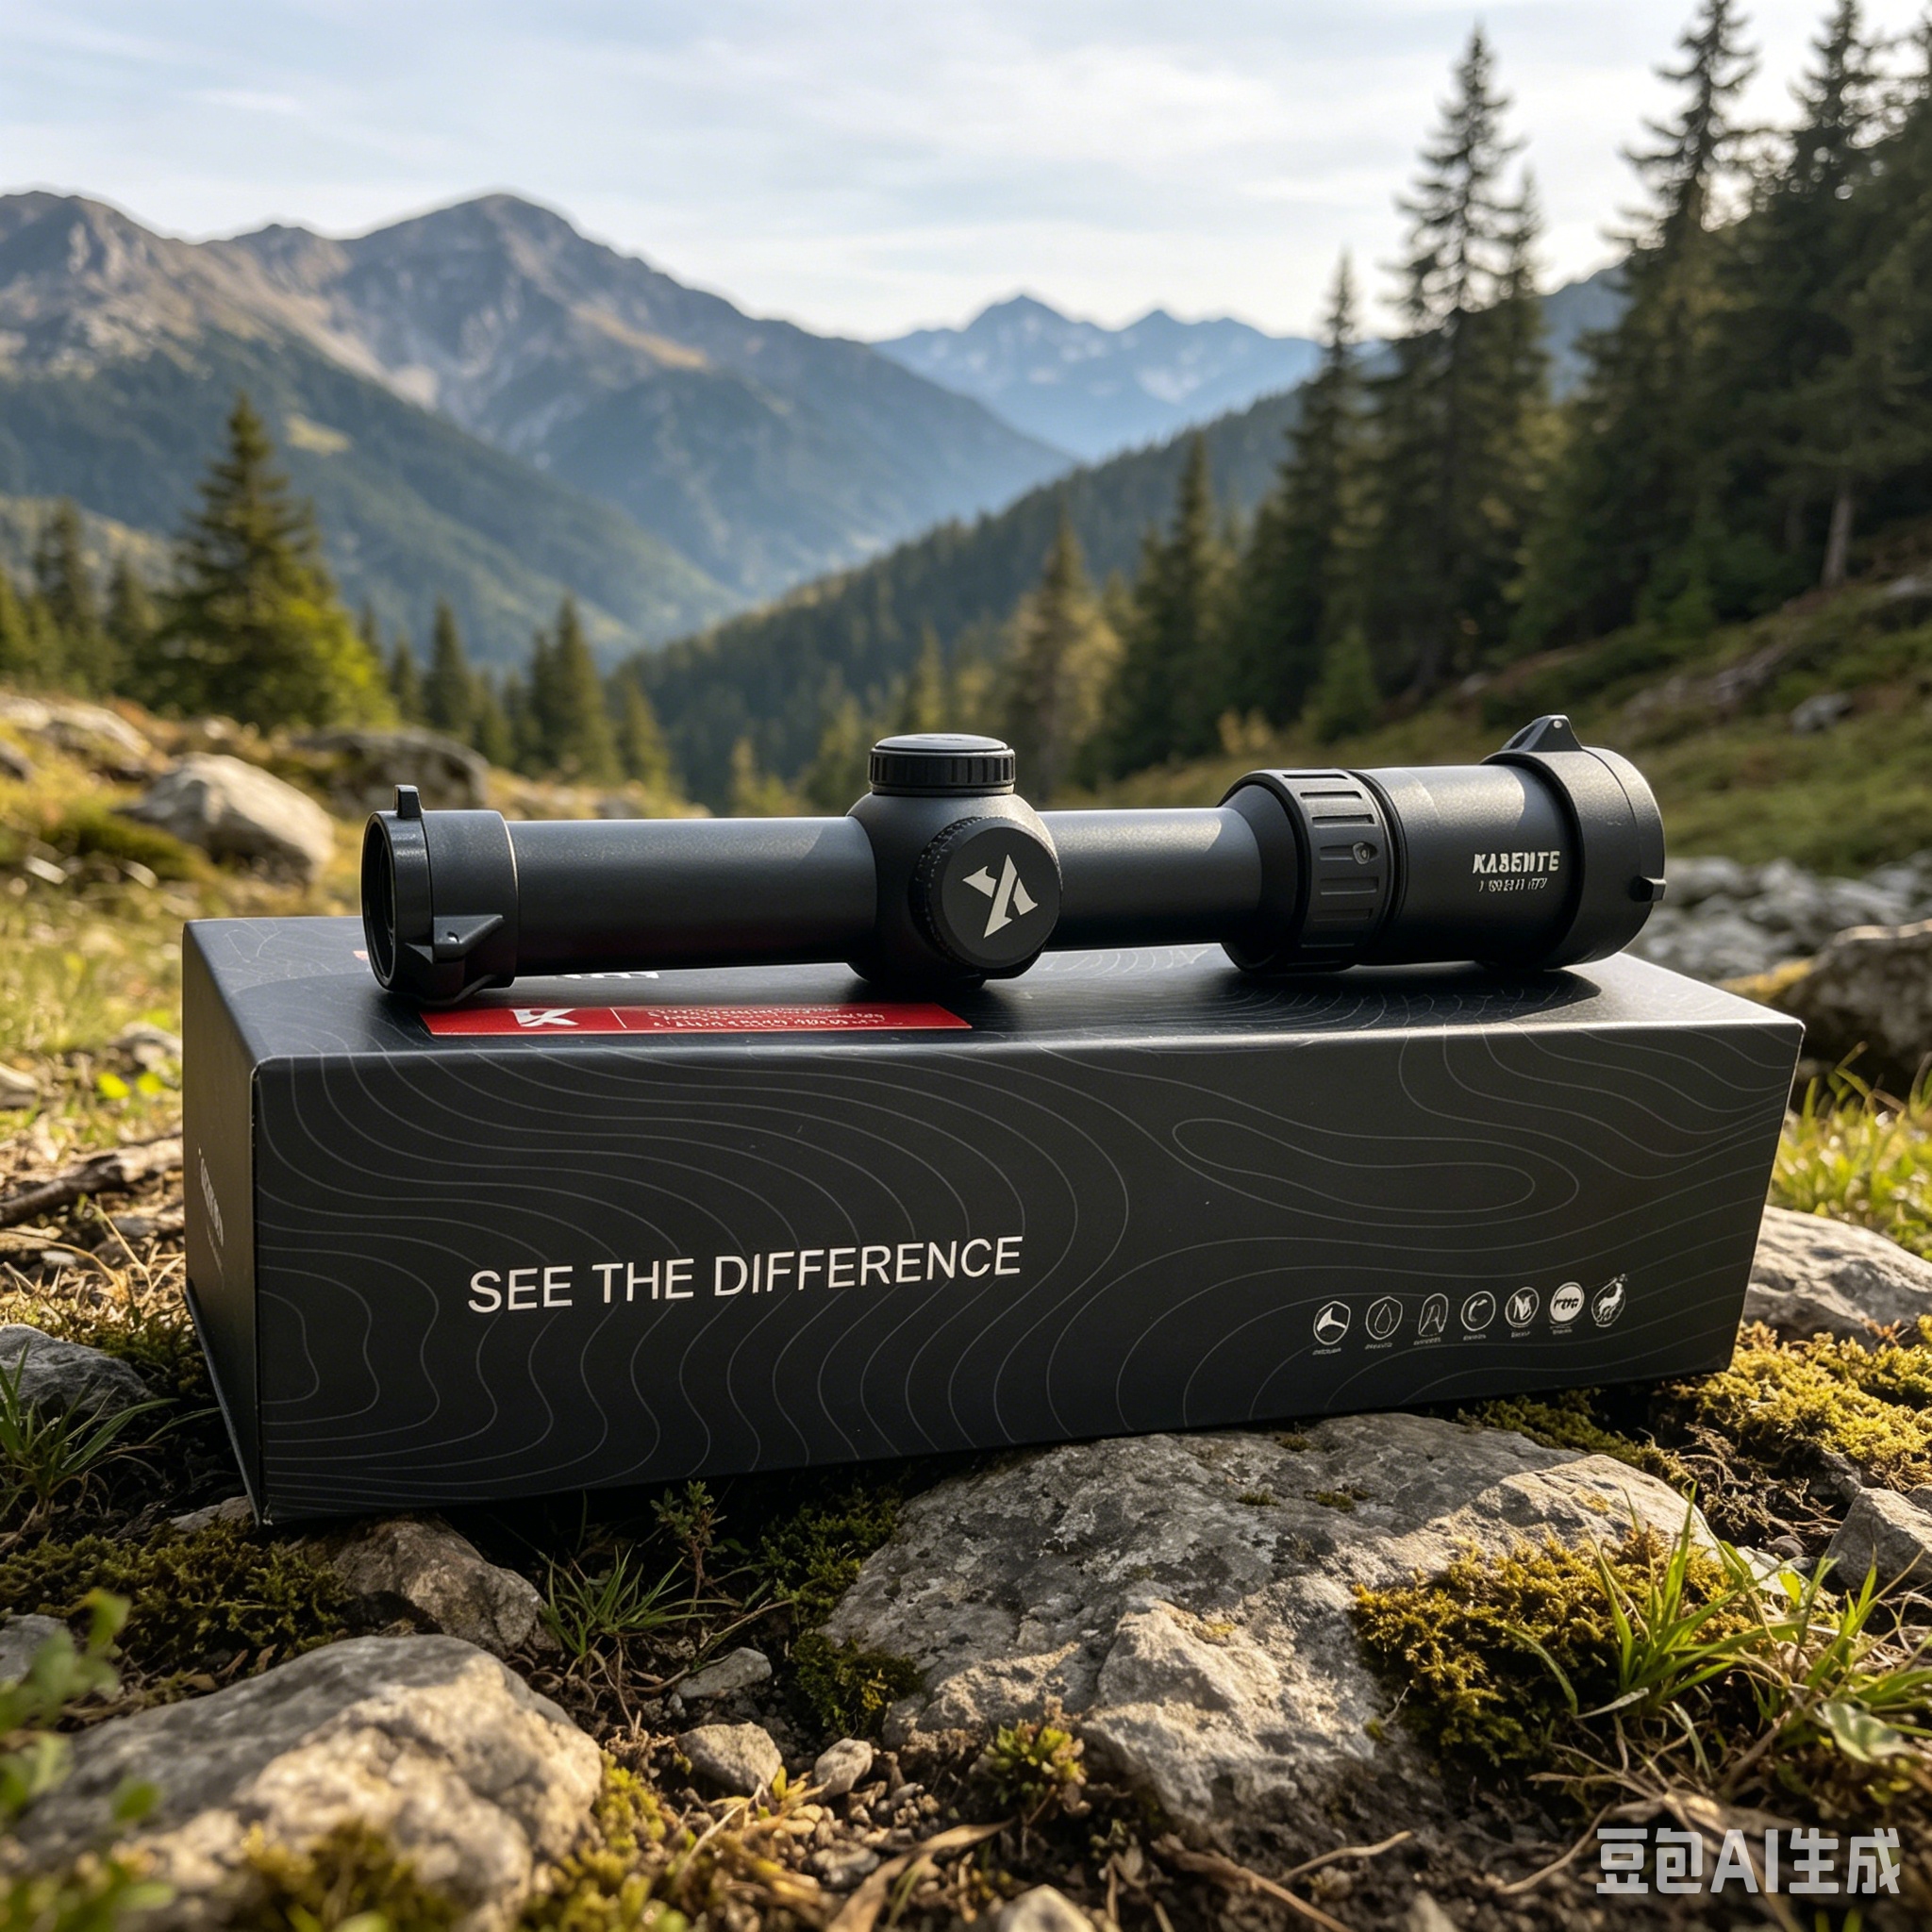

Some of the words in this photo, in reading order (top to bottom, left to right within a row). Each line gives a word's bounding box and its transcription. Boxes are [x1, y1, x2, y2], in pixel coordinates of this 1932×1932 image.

[468, 1266, 573, 1313] SEE
[591, 1258, 694, 1304] THE
[713, 1236, 1023, 1296] DIFFERENCE
